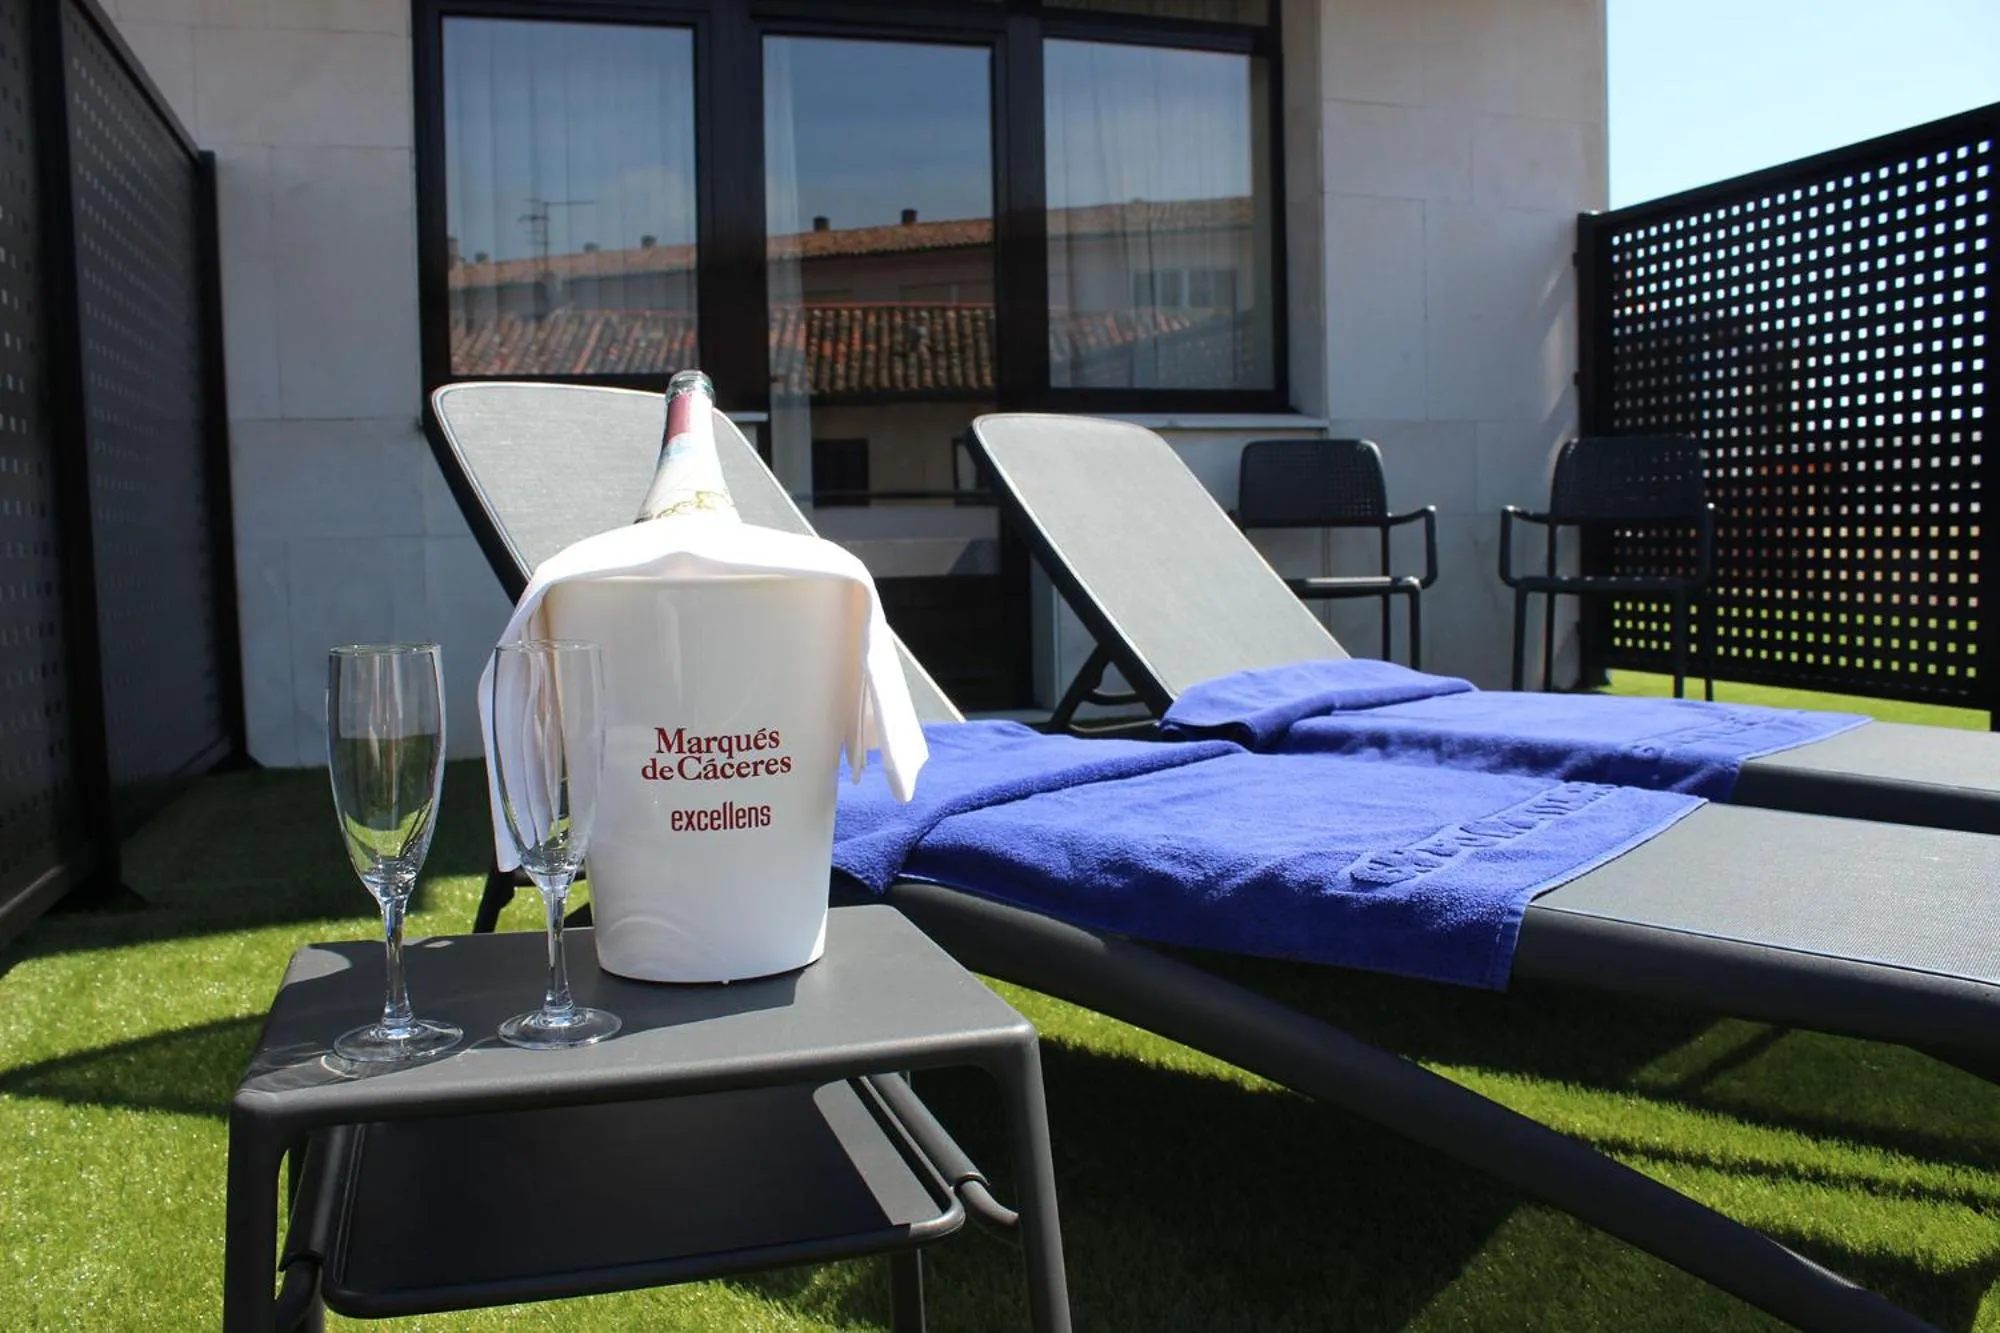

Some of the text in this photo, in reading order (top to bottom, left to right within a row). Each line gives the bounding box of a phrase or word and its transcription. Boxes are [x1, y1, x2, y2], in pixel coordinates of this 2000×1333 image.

[654, 726, 781, 760] Marqués
[641, 754, 793, 781] de Cáceres
[670, 801, 772, 832] excellens
